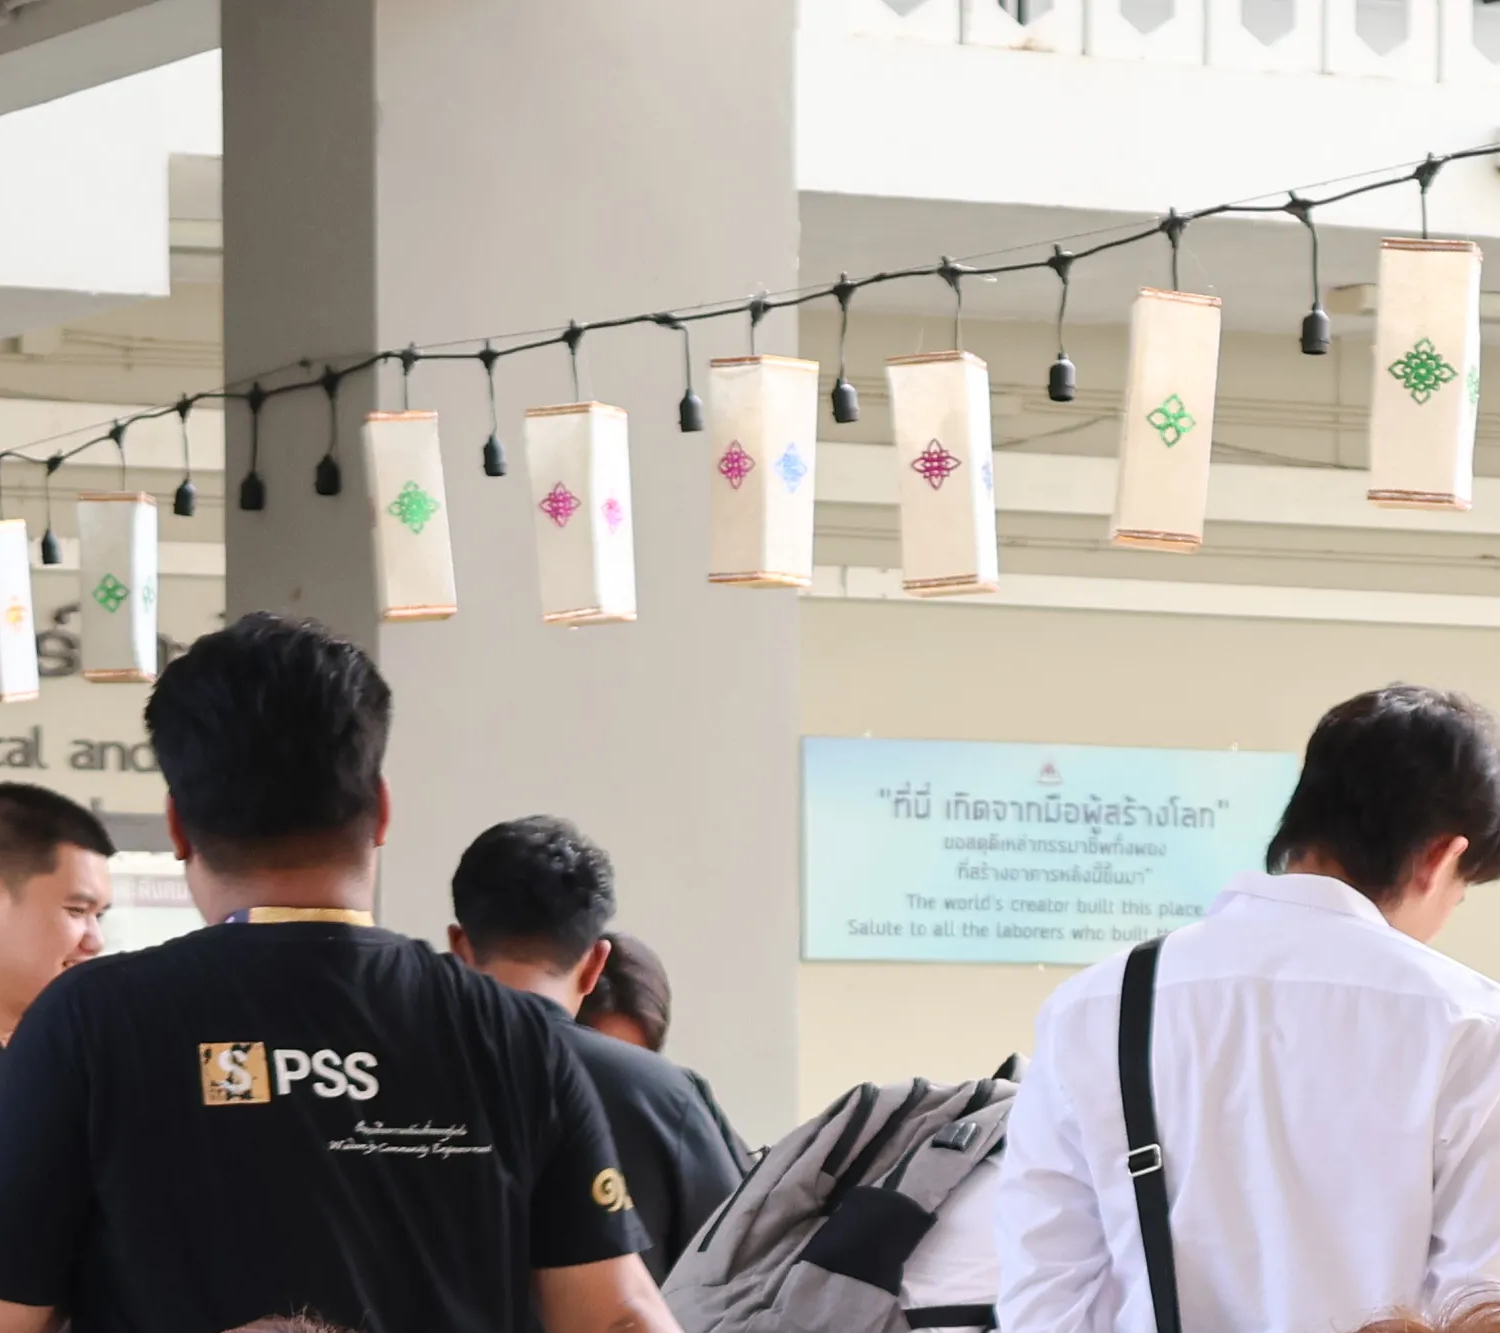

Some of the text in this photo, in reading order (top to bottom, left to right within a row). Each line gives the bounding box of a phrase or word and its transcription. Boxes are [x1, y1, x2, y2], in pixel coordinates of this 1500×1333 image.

[906, 893, 935, 912] The
[943, 894, 1004, 911] world's
[1010, 897, 1071, 913] creator
[1077, 897, 1115, 915] built
[1121, 899, 1152, 916] this
[847, 919, 903, 936] Salute
[910, 922, 927, 937] to
[933, 920, 955, 937] all
[962, 921, 989, 938] the
[996, 922, 1065, 940] laborers
[1071, 924, 1106, 941] who
[273, 1049, 380, 1100] PSS
